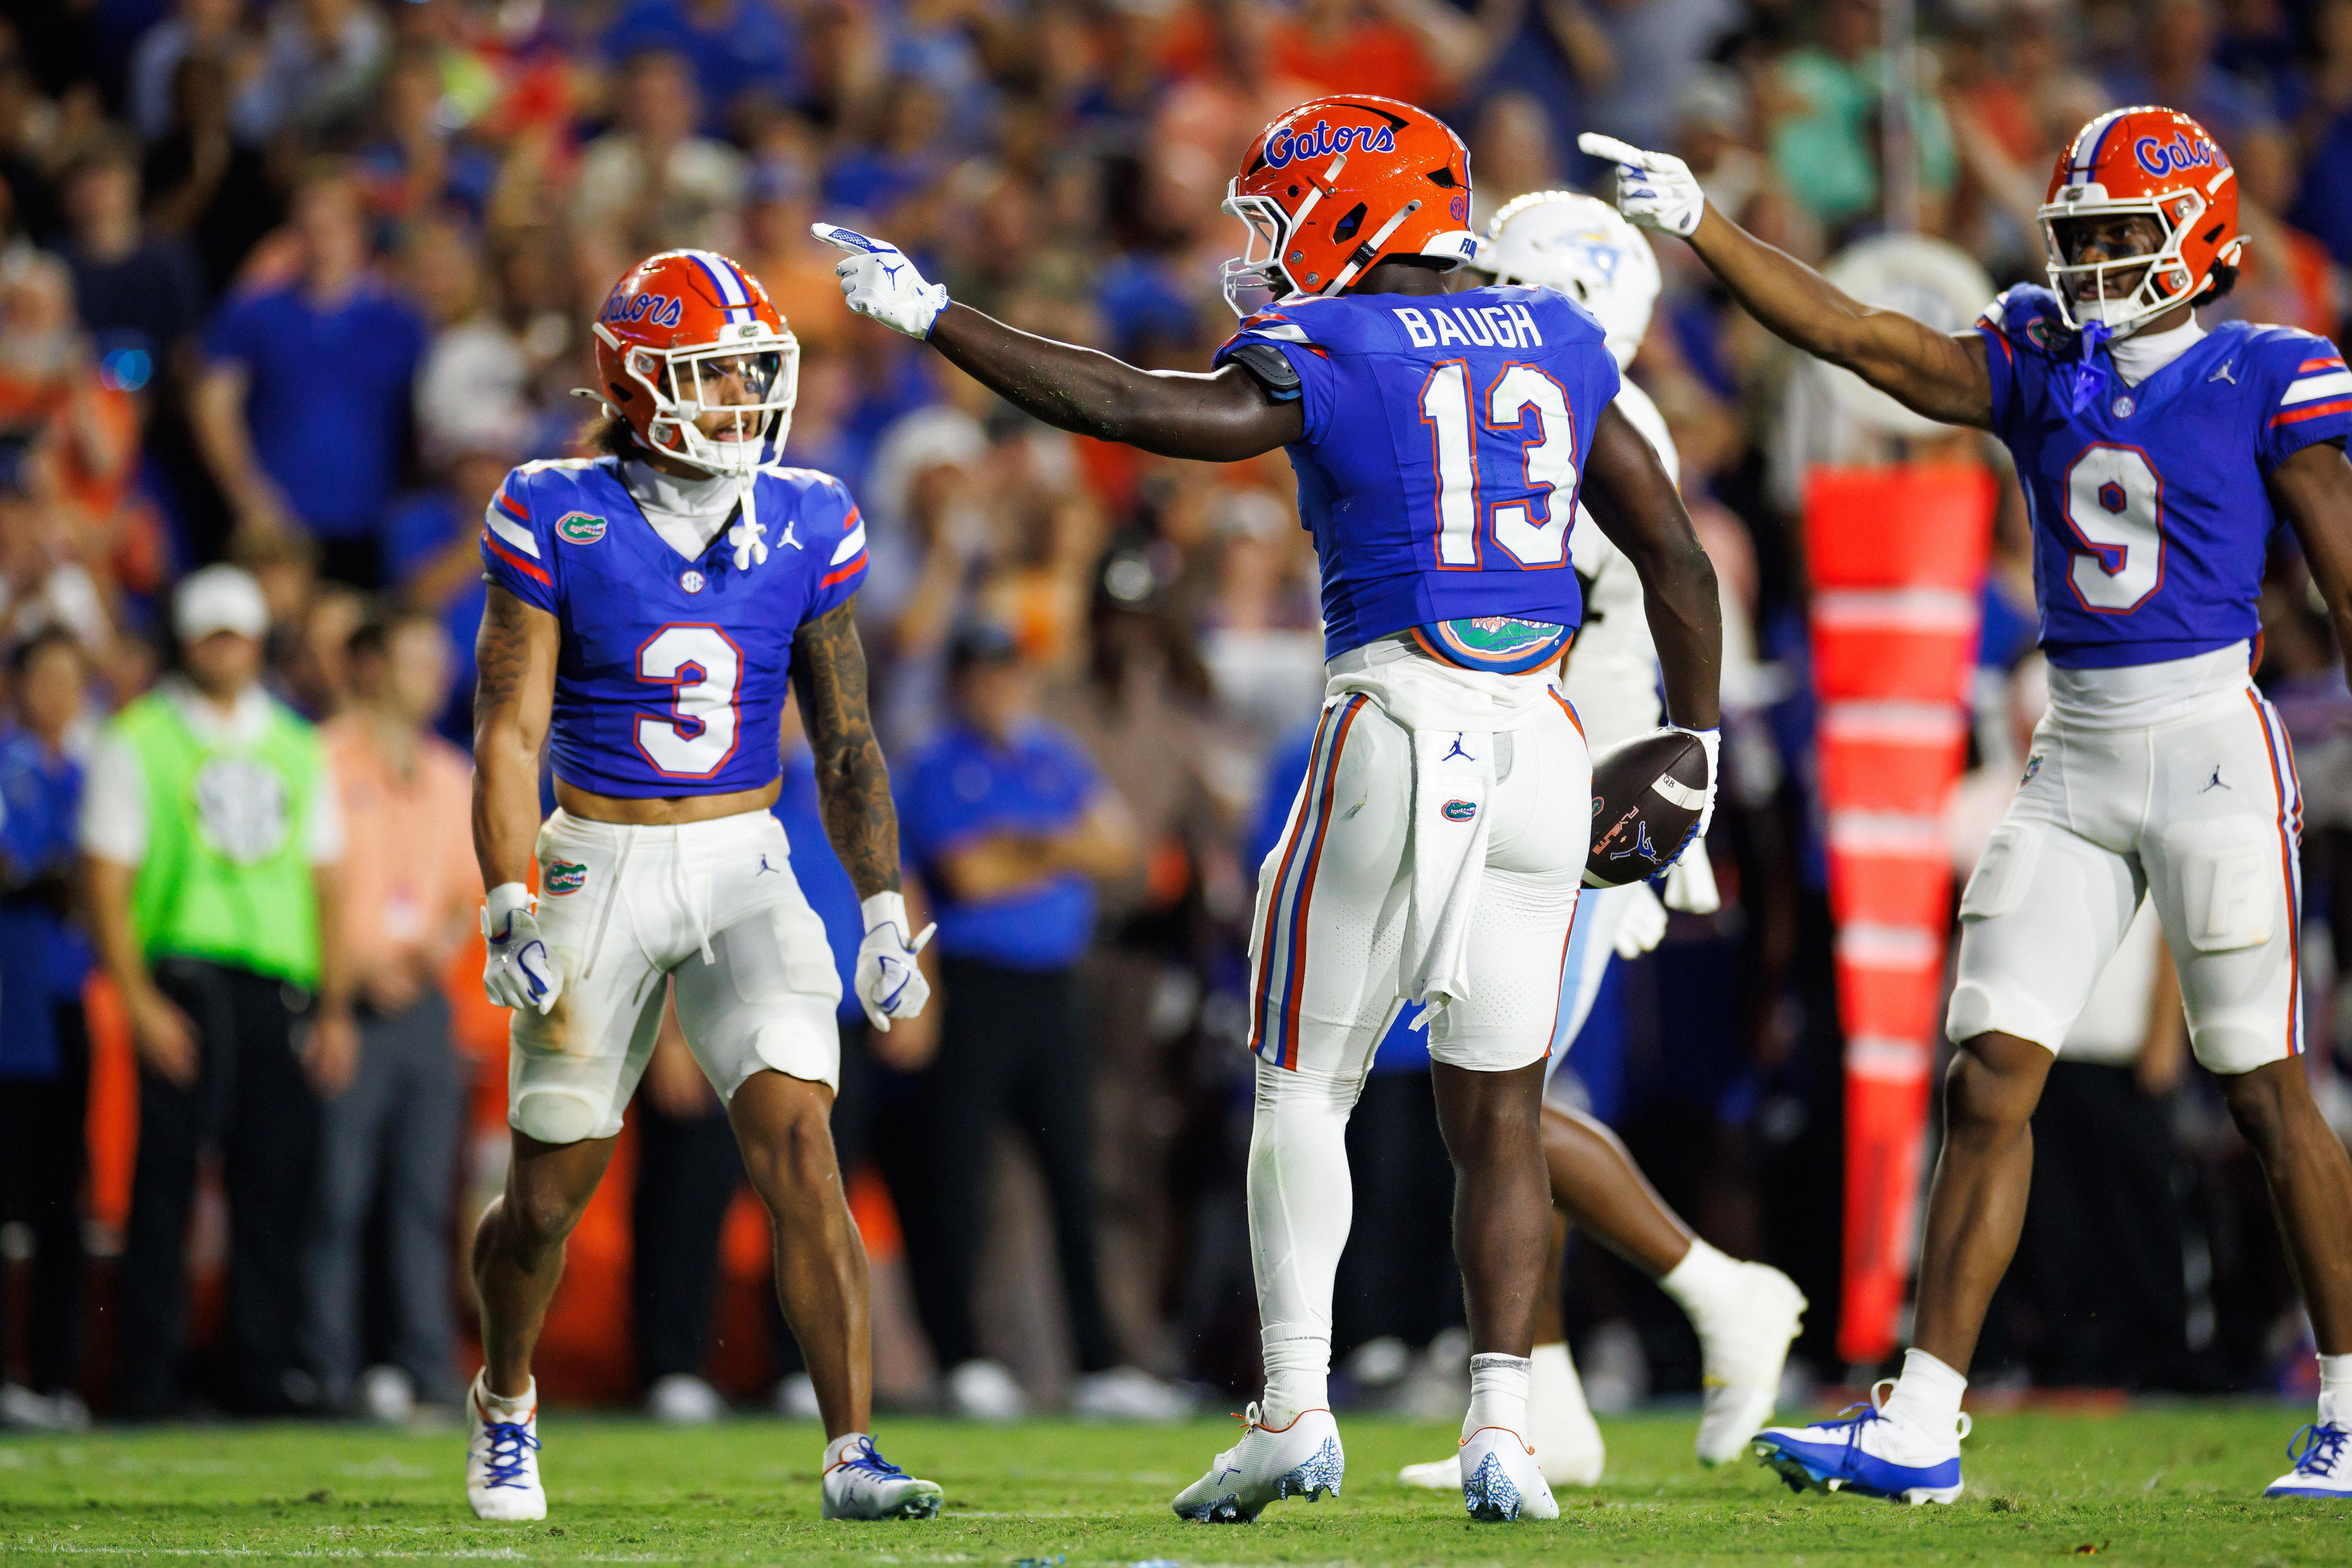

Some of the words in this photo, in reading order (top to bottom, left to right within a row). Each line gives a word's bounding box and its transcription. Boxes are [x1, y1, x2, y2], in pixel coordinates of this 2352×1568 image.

[1263, 120, 1396, 169] Gators
[1392, 304, 1543, 348] BAUGH
[1418, 357, 1580, 572] 13
[2063, 441, 2167, 615] 9
[633, 622, 744, 780] 3
[1663, 776, 1675, 788] QB
